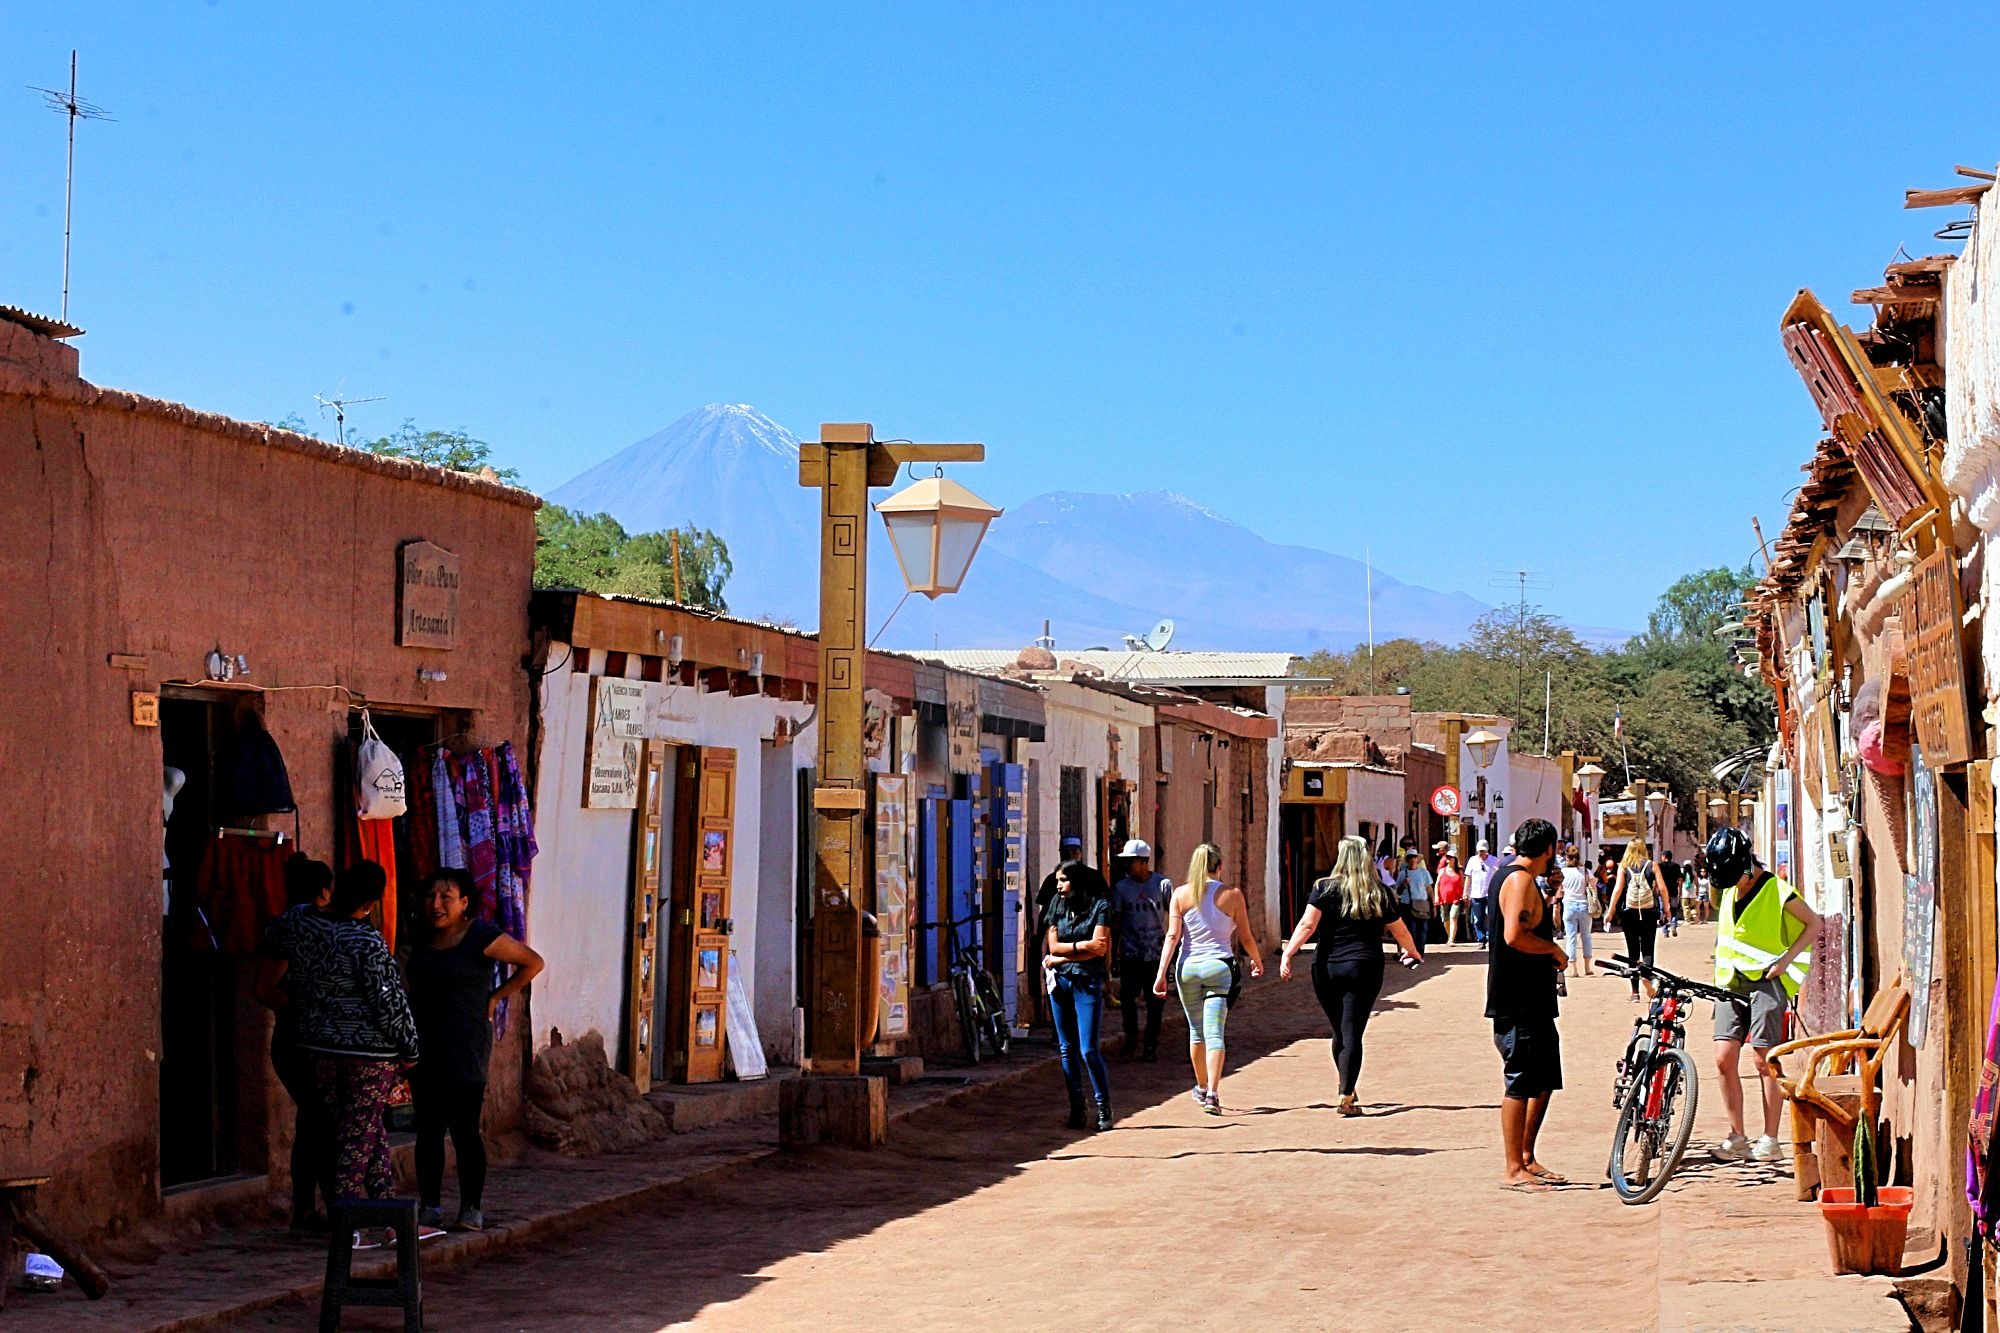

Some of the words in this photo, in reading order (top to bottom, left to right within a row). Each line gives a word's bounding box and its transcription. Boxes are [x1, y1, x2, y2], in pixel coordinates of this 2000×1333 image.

[437, 565, 458, 589] Puna
[407, 609, 448, 636] Artesania
[626, 723, 643, 736] TRAVEL
